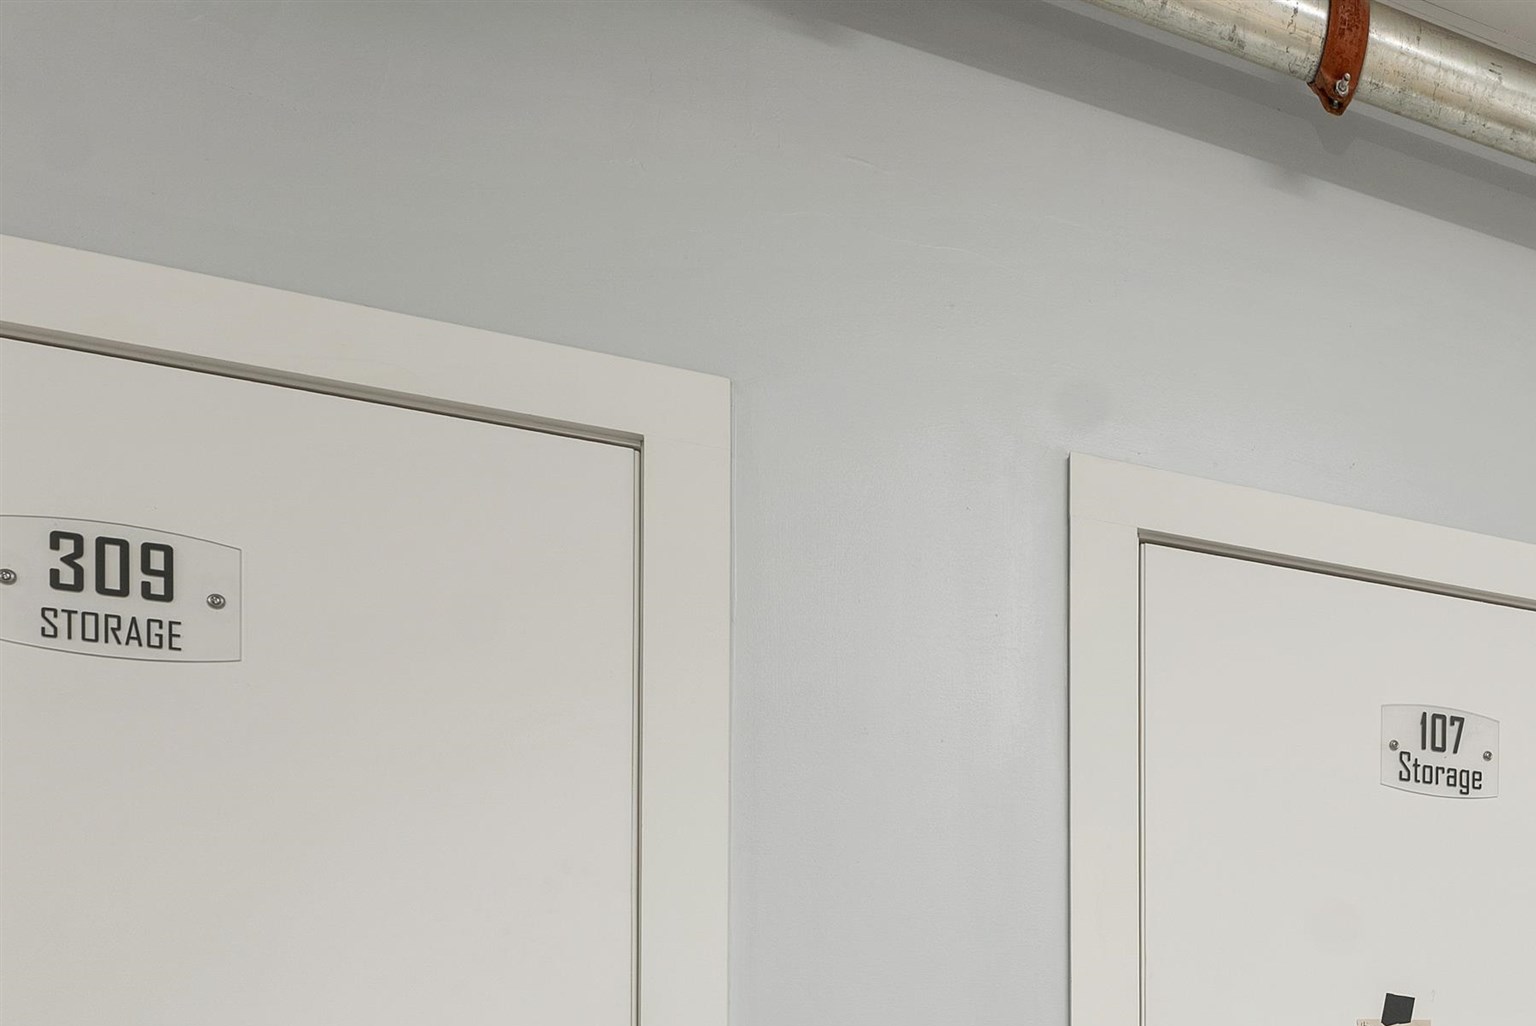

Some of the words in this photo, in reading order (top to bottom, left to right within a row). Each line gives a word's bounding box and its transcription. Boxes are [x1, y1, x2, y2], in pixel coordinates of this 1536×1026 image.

[50, 530, 174, 603] 309
[41, 607, 182, 651] STORAGE
[1420, 711, 1465, 754] 107
[1399, 751, 1482, 795] Storage
